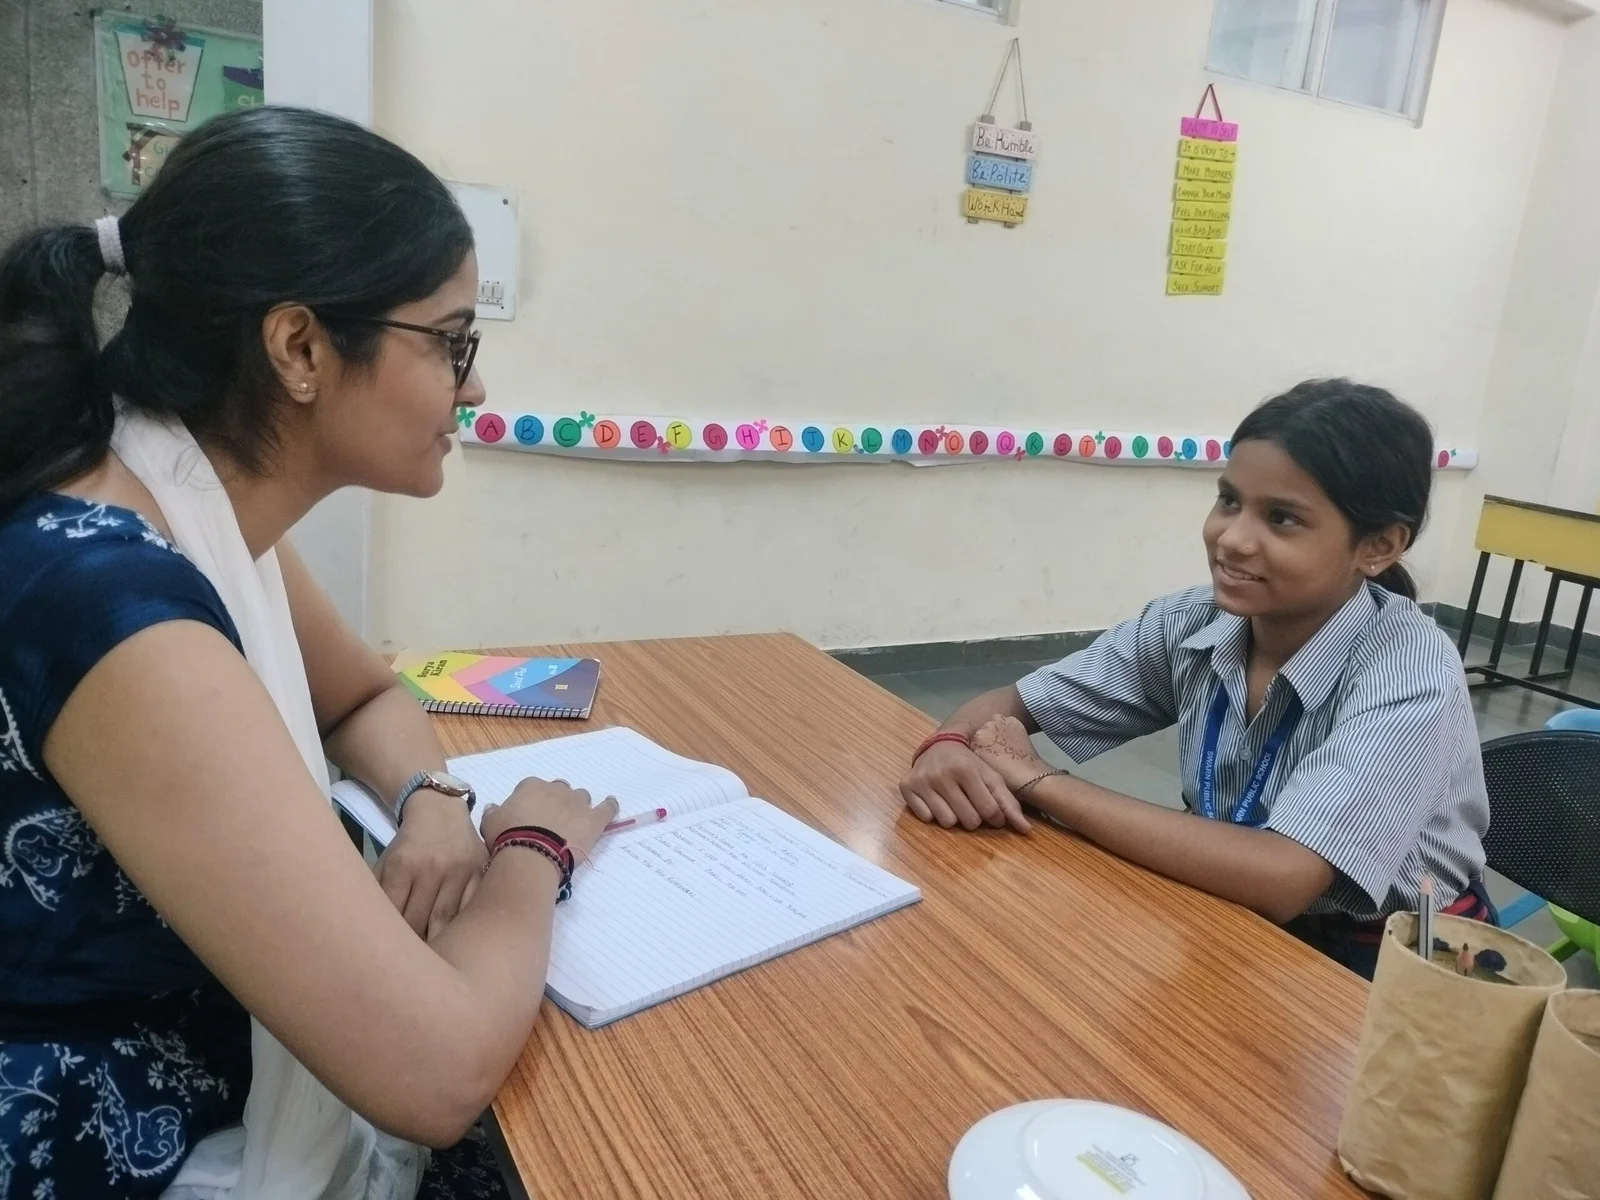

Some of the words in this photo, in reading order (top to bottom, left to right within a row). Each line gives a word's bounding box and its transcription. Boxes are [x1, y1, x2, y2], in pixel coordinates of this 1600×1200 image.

[141, 71, 166, 91] to
[136, 88, 180, 119] help
[976, 127, 991, 148] Be
[995, 131, 1035, 154] Humble
[972, 160, 987, 180] Be
[989, 163, 1026, 184] Polite
[429, 659, 447, 676] Kiran
[1205, 751, 1214, 779] SWARN
[1242, 781, 1260, 808] PUBLIC
[1255, 752, 1272, 780] SCHOOL
[1203, 781, 1212, 810] PUBLIC
